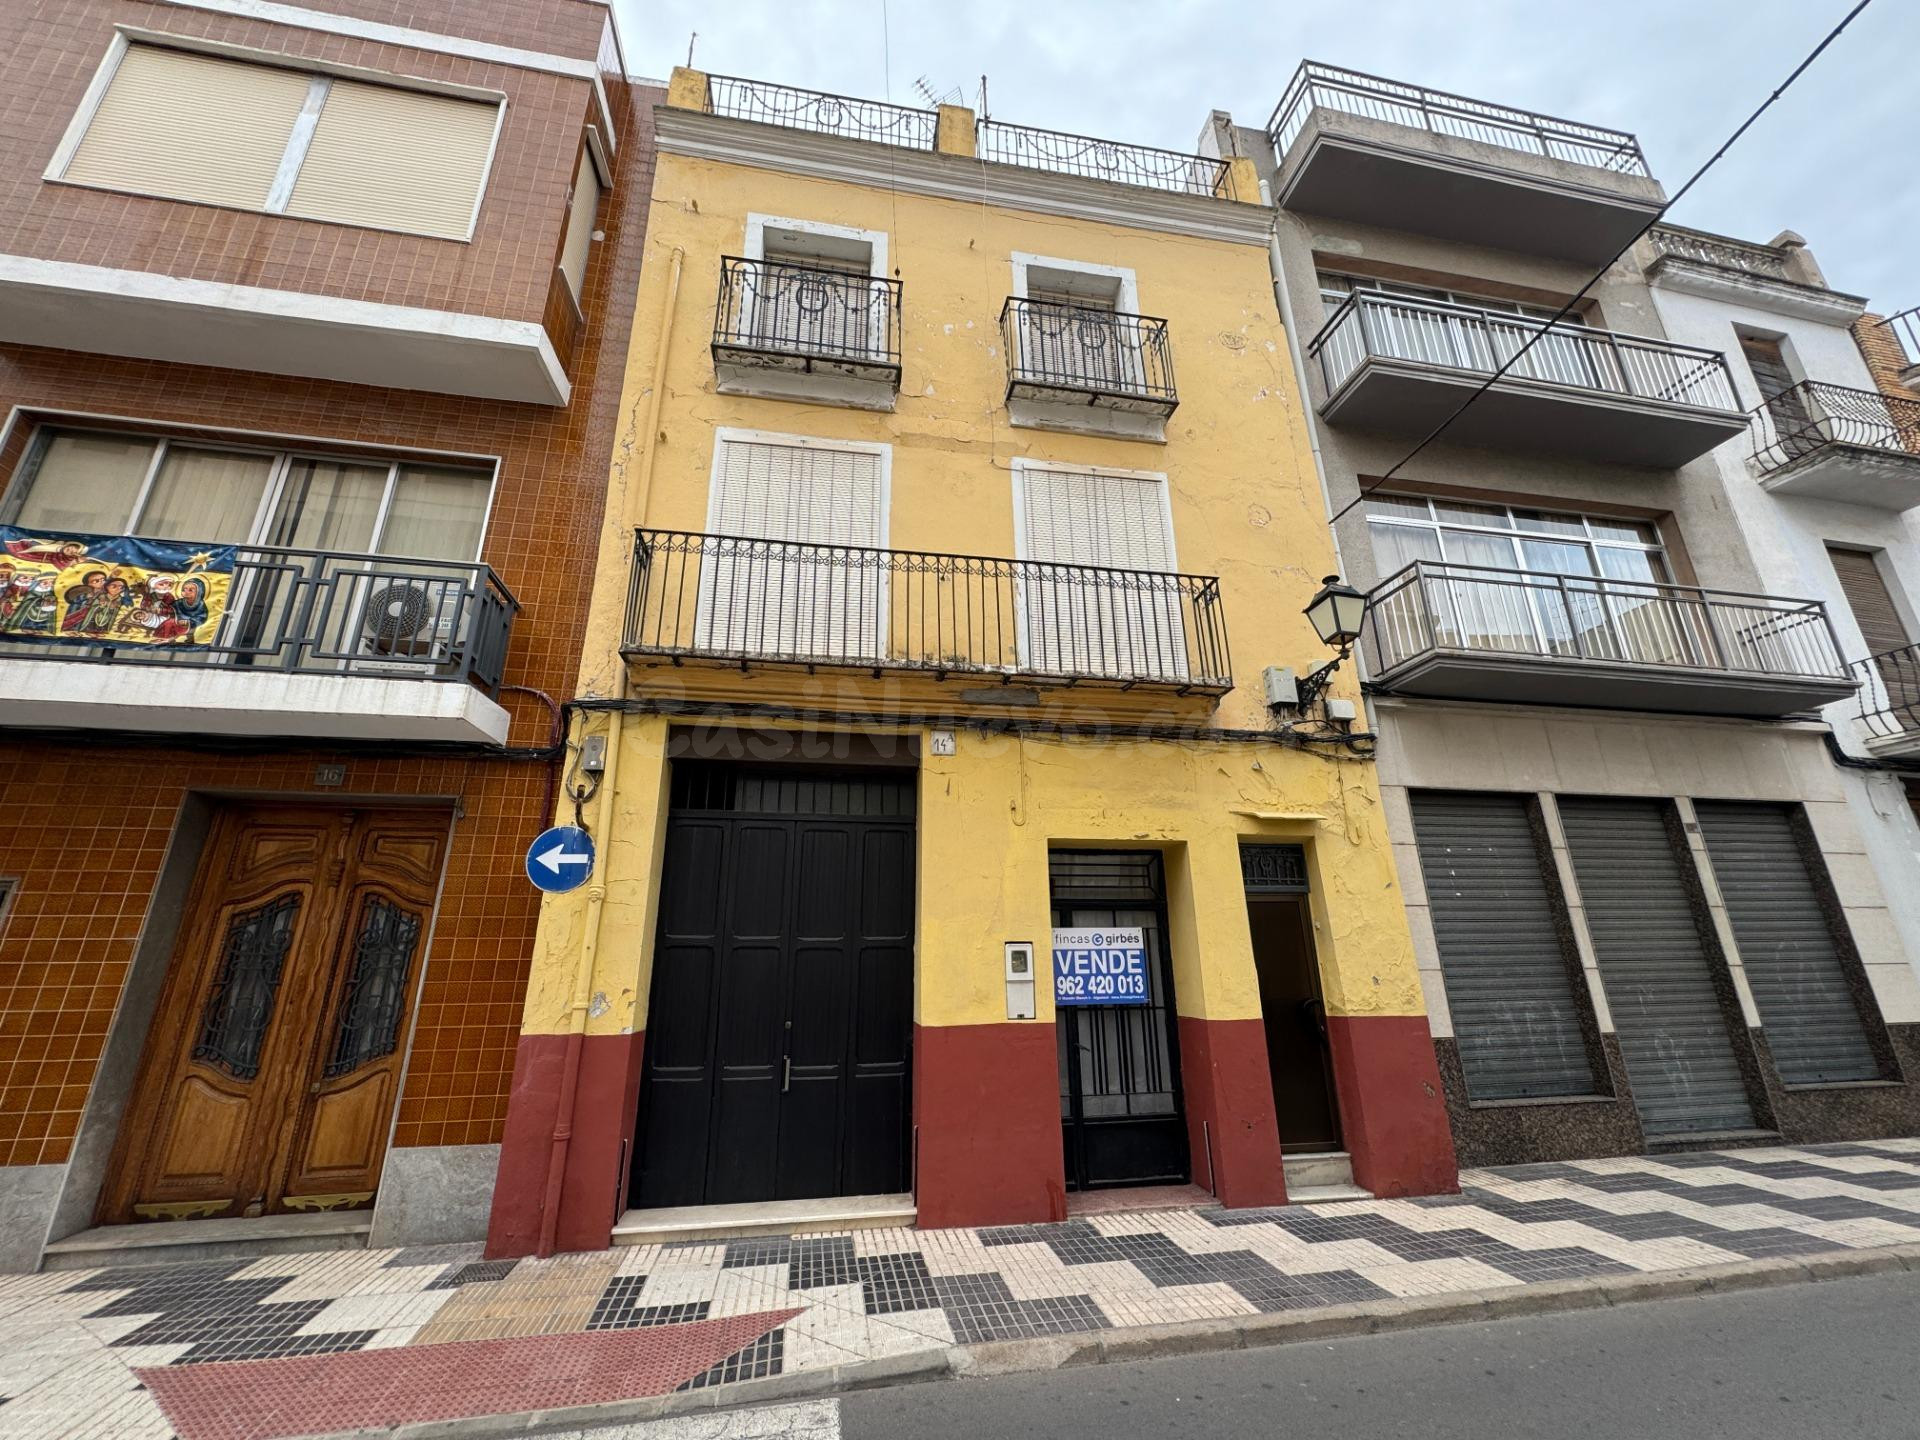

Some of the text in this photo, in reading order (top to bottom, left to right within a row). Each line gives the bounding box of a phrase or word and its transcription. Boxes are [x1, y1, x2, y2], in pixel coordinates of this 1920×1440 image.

[1055, 934, 1090, 944] fincas
[1056, 950, 1143, 975] VENDE
[1057, 975, 1144, 995] 962 420 013
